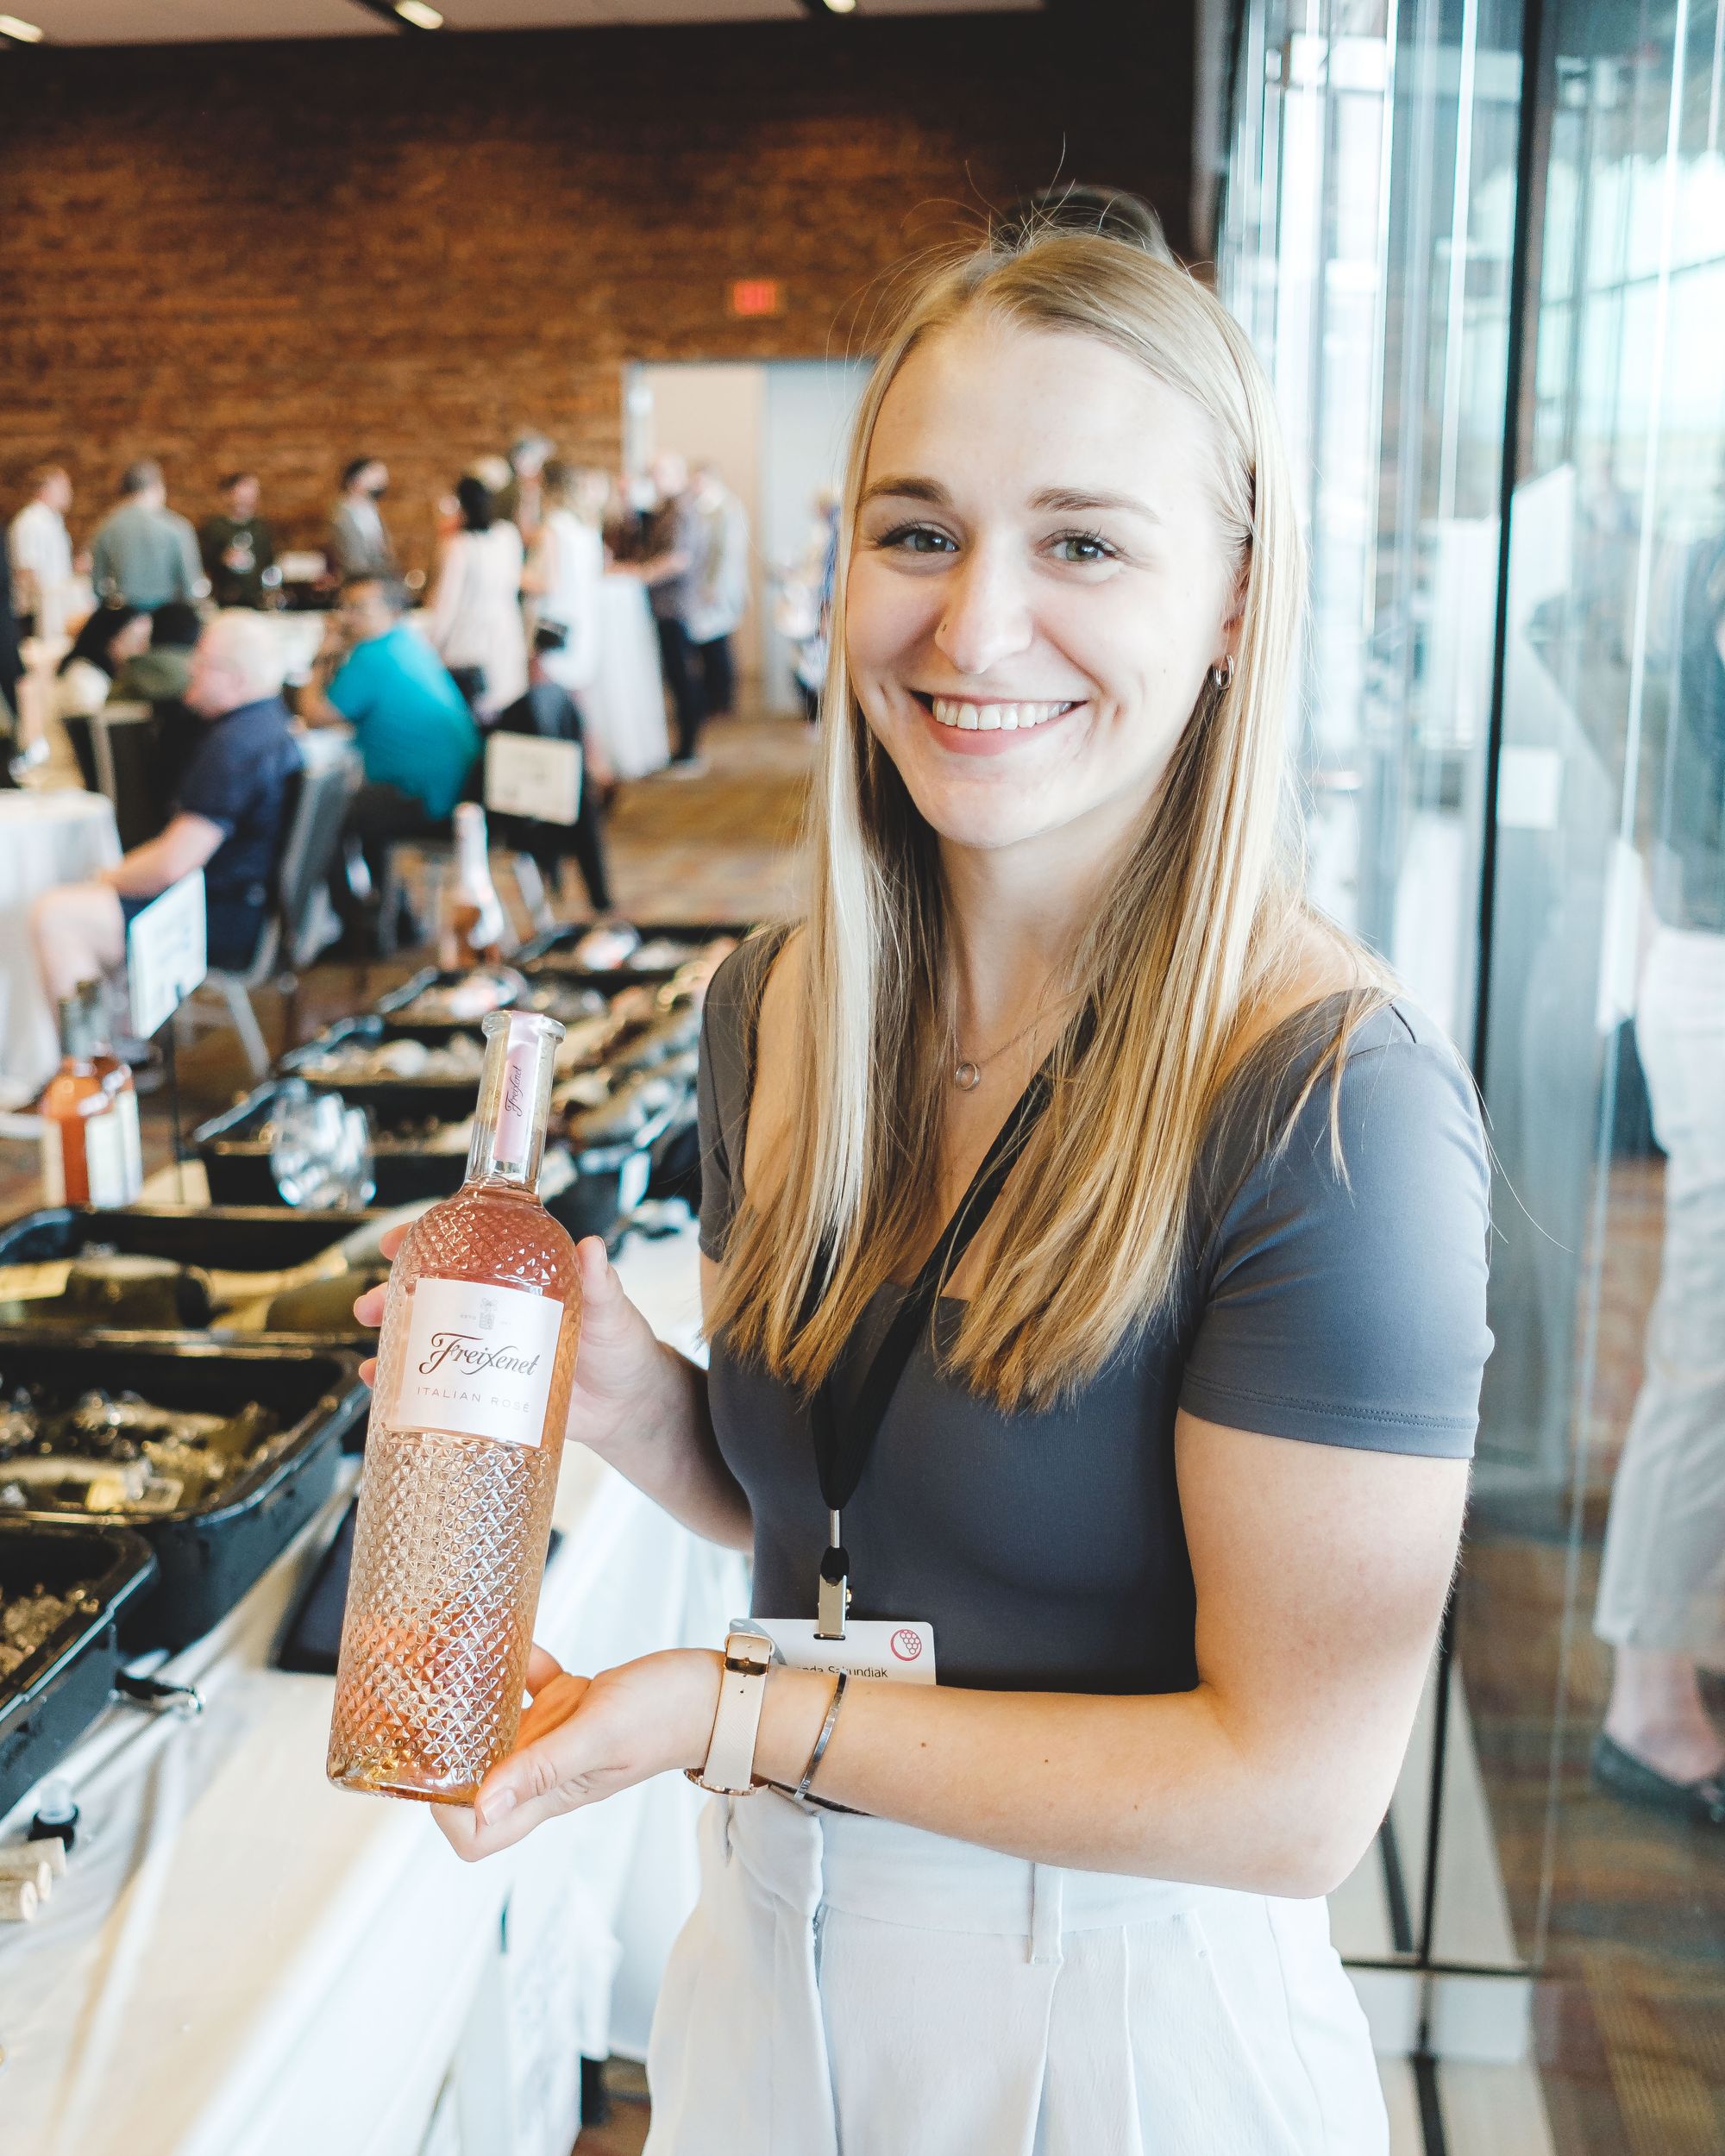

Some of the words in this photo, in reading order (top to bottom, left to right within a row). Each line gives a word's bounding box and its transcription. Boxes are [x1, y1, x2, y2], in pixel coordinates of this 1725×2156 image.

[505, 1065, 524, 1117] Freixenet
[418, 1332, 541, 1376] Freixenet
[417, 1386, 481, 1403] ITALIAN
[491, 1396, 532, 1413] ROSÉ
[828, 1665, 888, 1678] Saundiak
